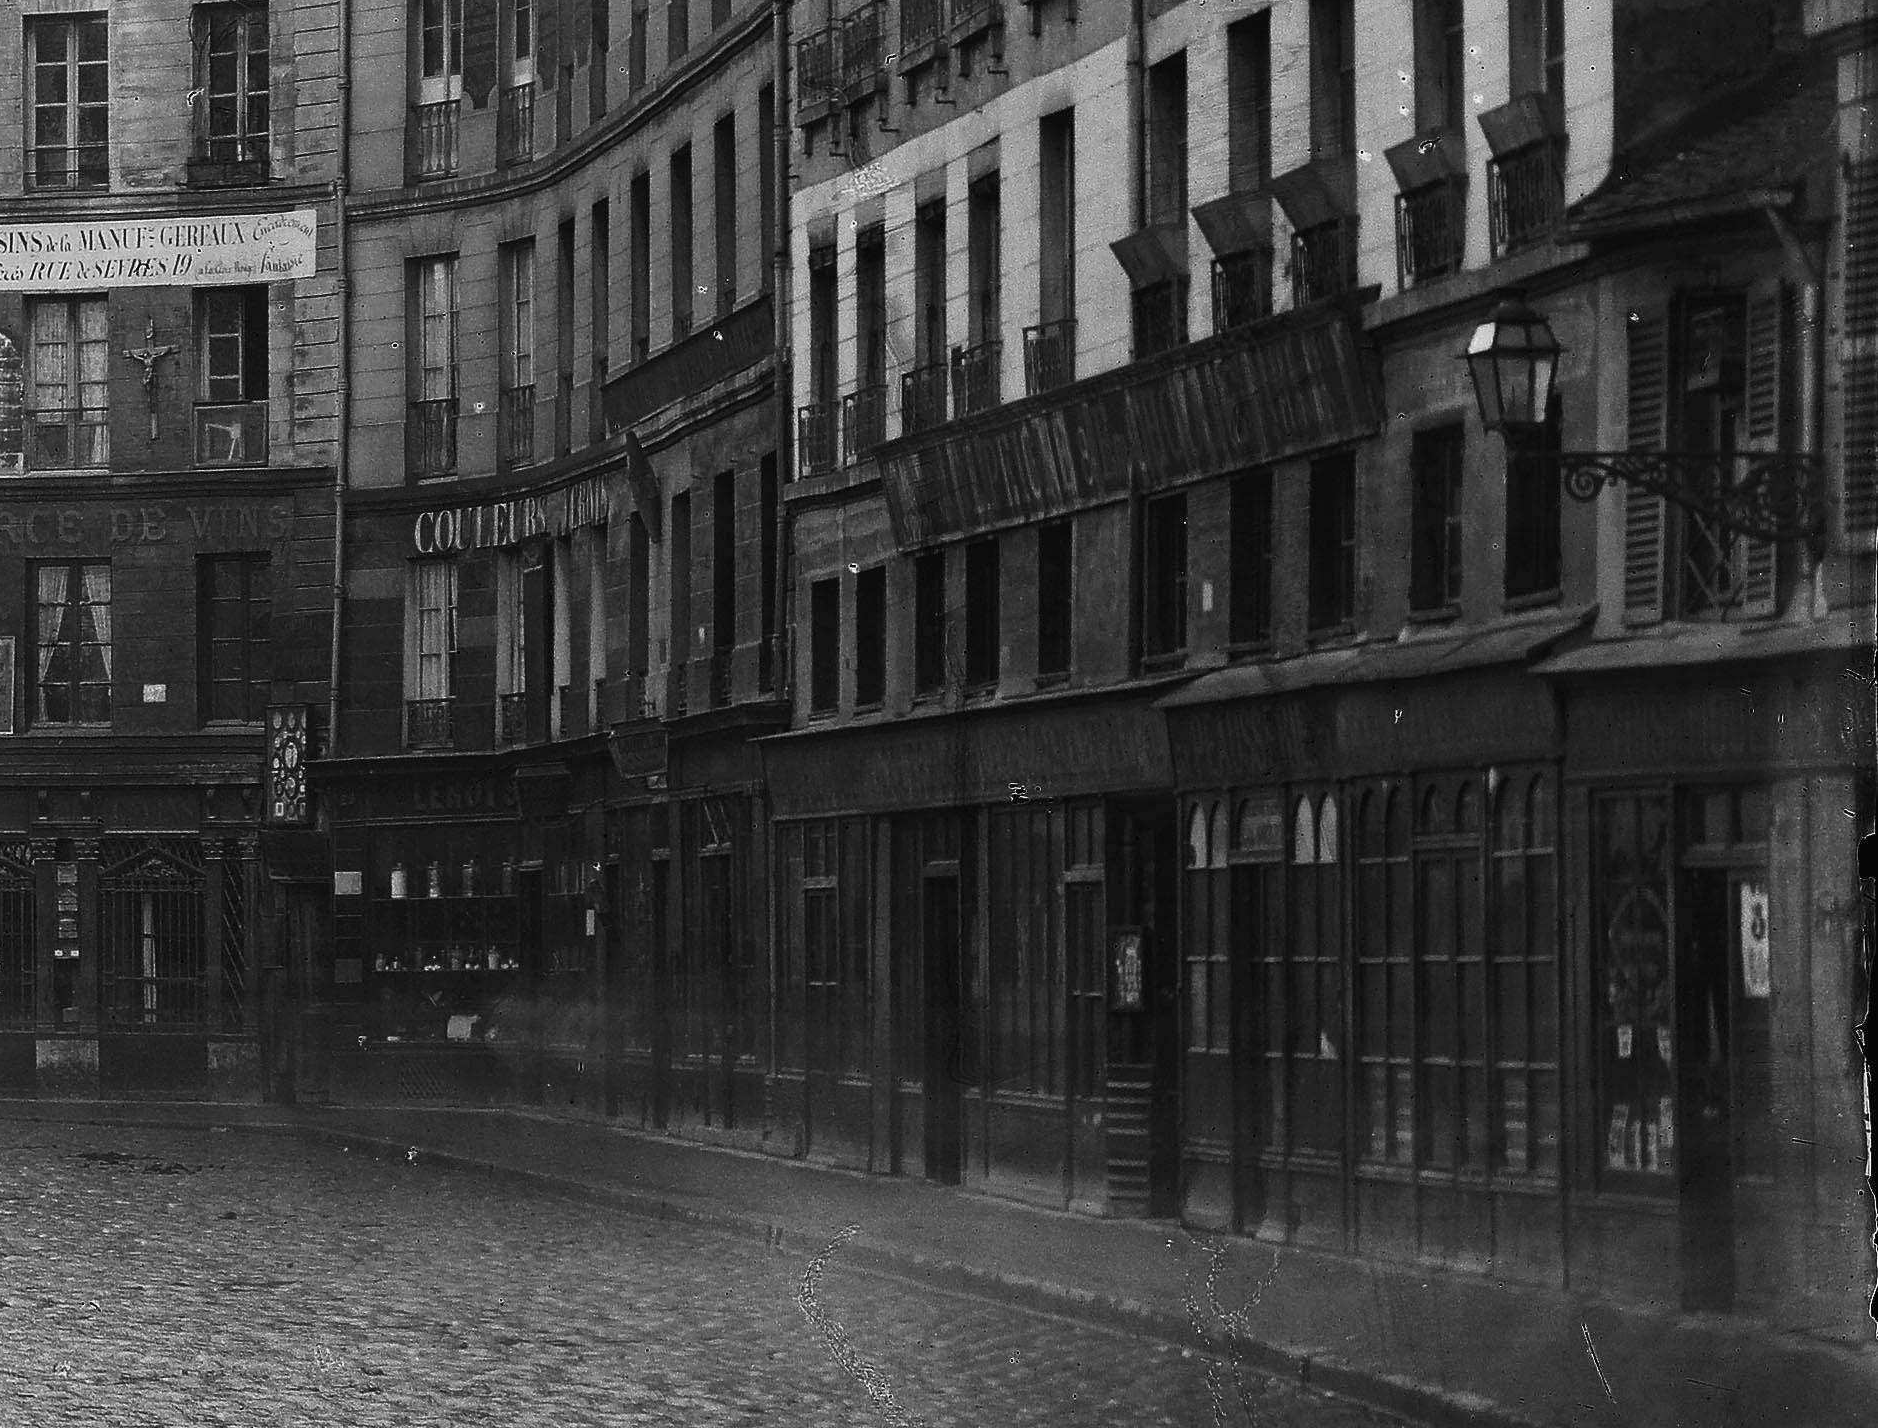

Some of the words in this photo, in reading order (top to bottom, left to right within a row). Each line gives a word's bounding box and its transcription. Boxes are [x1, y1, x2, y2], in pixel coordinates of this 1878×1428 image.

[28, 260, 74, 281] RUE
[172, 253, 193, 276] 19
[110, 506, 167, 543] DE
[185, 504, 290, 540] VINS
